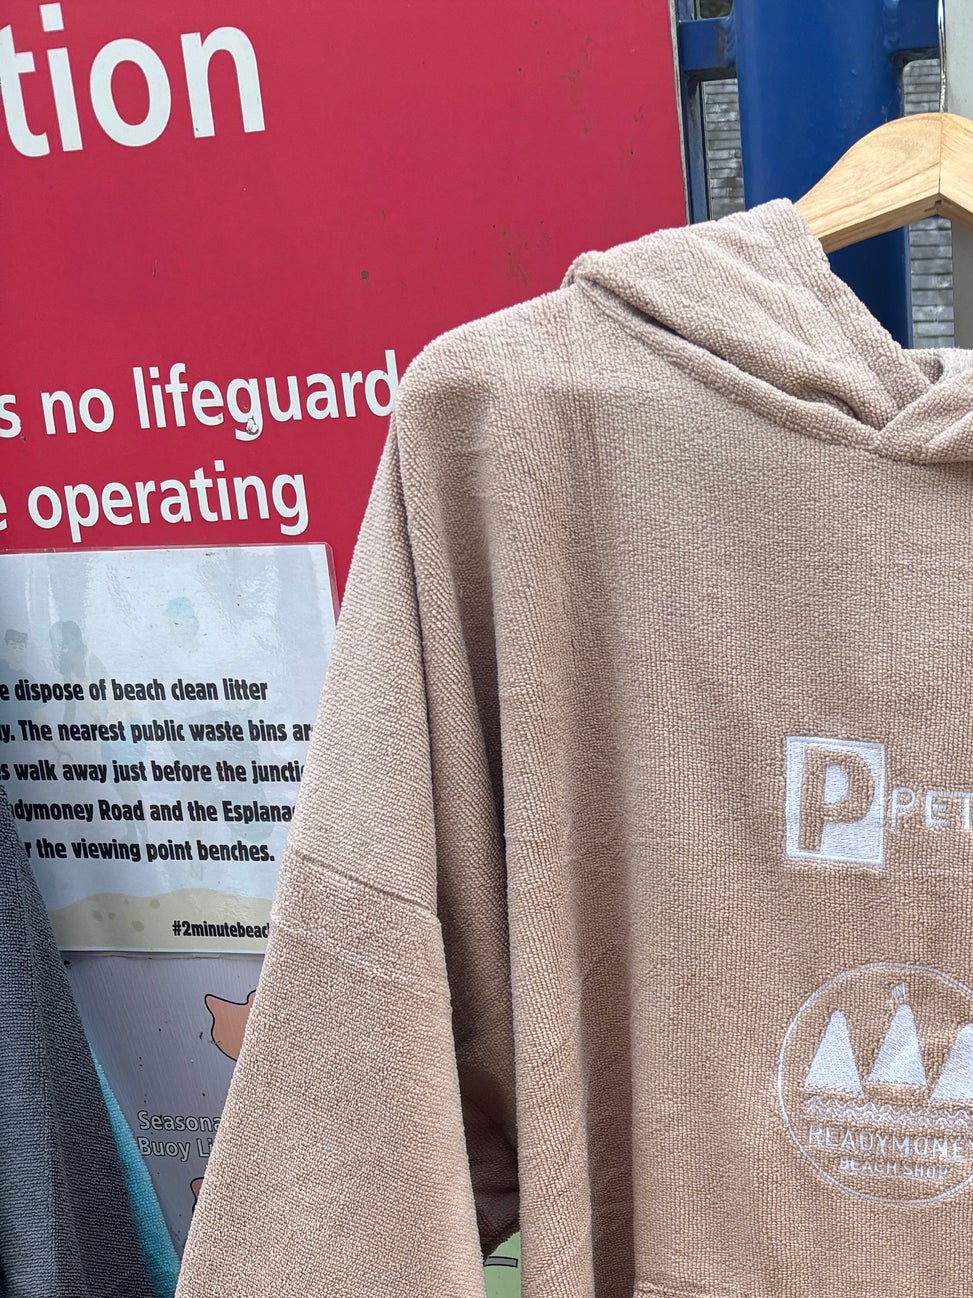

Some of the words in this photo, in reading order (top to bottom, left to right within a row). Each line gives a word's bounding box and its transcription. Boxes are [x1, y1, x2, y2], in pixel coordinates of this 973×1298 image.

[0, 2, 266, 158] tion
[40, 388, 115, 435] no
[133, 349, 399, 442] lifeguard
[27, 460, 310, 544] operating
[15, 679, 84, 703] dispose
[89, 679, 107, 701] of
[111, 679, 166, 701] beach
[171, 679, 218, 701] clean
[222, 678, 268, 701] litter
[18, 719, 52, 741] The
[58, 721, 125, 742] nearest
[131, 721, 185, 743] public
[190, 722, 244, 742] waste
[250, 720, 287, 742] bins
[292, 723, 314, 742] ar
[14, 760, 58, 781] walk
[63, 763, 107, 784] away
[113, 761, 147, 783] just
[151, 760, 212, 782] before
[216, 761, 247, 782] the
[252, 761, 304, 784] juncti
[99, 799, 144, 821] Road
[150, 800, 183, 822] and
[188, 801, 218, 822] the
[223, 801, 296, 824] Esplana
[36, 838, 67, 859] the
[71, 838, 140, 861] viewing
[147, 840, 193, 861] point
[199, 840, 275, 862] benches.
[172, 920, 269, 938] #2minutebeac
[137, 1136, 191, 1162] Buoy
[839, 1156, 897, 1176] BEACH
[903, 1164, 949, 1179] SHOP
